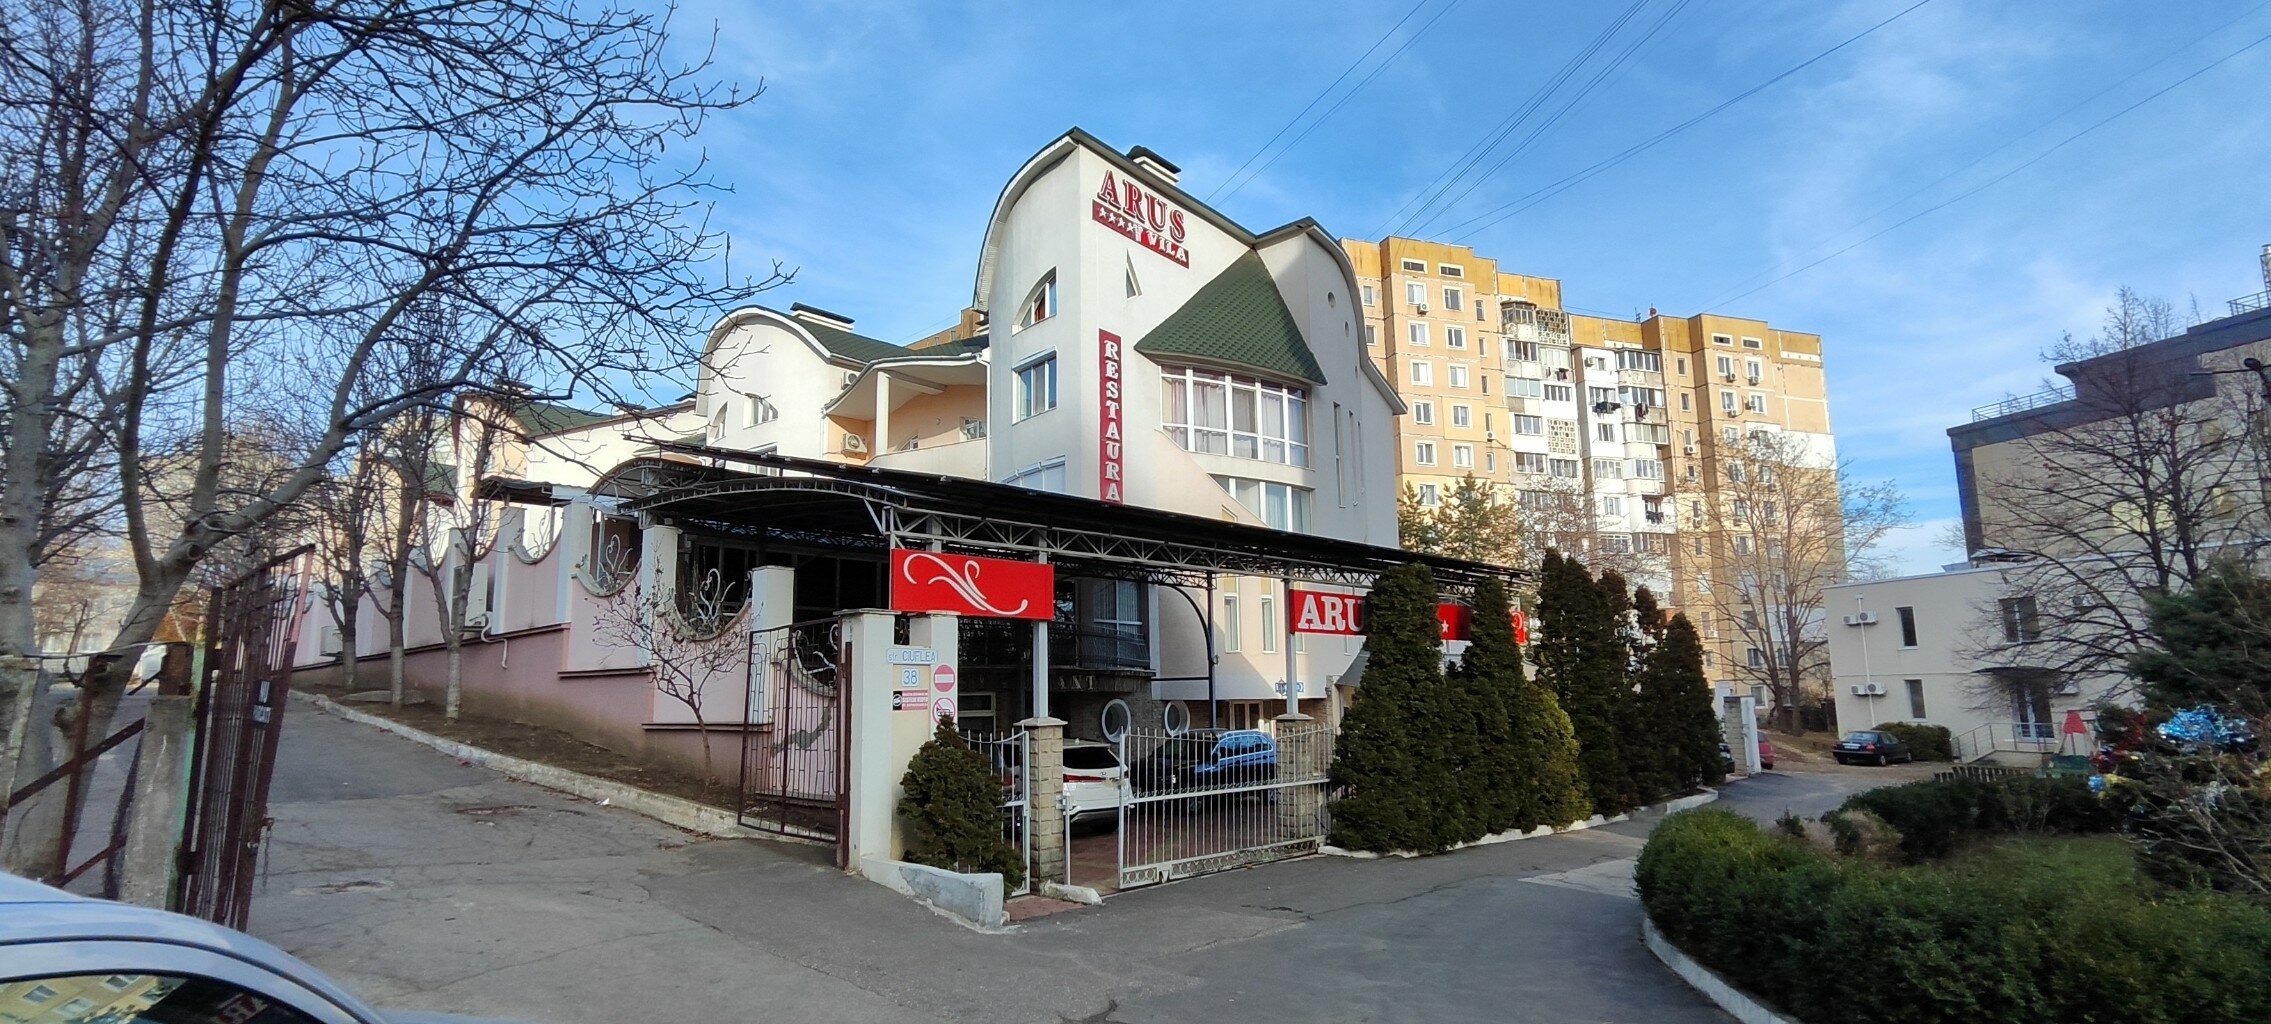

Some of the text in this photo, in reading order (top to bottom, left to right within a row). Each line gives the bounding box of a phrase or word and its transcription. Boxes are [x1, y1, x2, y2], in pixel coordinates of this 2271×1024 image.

[1097, 169, 1186, 244] ARUS
[1146, 231, 1188, 262] VILA
[1103, 339, 1121, 502] RESTAURA
[902, 650, 936, 662] CIUFLEA
[903, 669, 918, 685] 38
